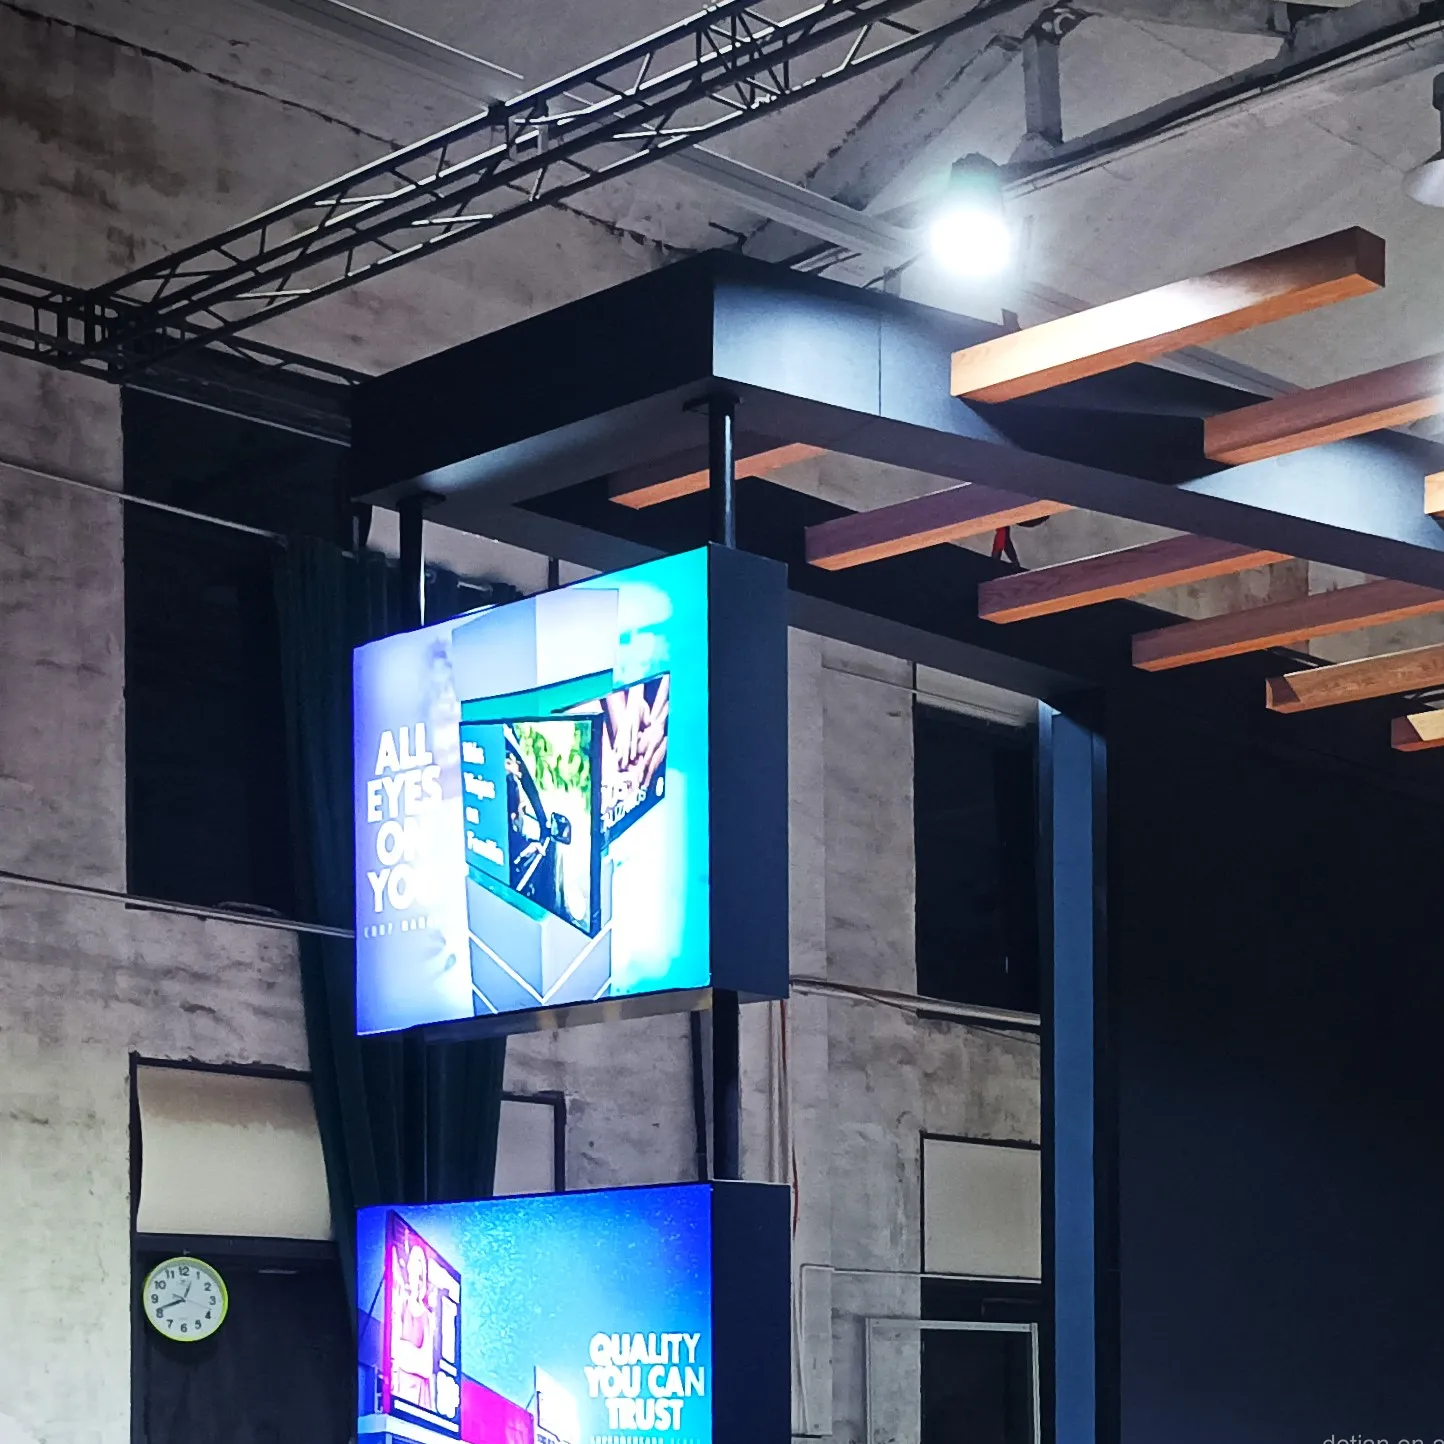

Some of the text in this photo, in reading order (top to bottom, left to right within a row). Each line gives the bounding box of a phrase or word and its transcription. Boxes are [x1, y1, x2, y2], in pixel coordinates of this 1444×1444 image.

[375, 723, 432, 775] ALL
[367, 765, 443, 823] EYES
[165, 1270, 175, 1279] 11
[179, 1266, 190, 1276] 12
[196, 1271, 201, 1280] 1
[154, 1280, 167, 1290] 10
[204, 1282, 212, 1291] 2
[151, 1294, 159, 1304] 9
[209, 1295, 217, 1306] 3
[156, 1308, 164, 1319] 8
[204, 1310, 212, 1320] 4
[166, 1319, 174, 1329] 7
[180, 1323, 188, 1333] 6
[194, 1320, 202, 1330] 5
[589, 1332, 701, 1365] QUALITY
[584, 1365, 705, 1398] YOU CAN
[606, 1397, 684, 1430] TRUST
